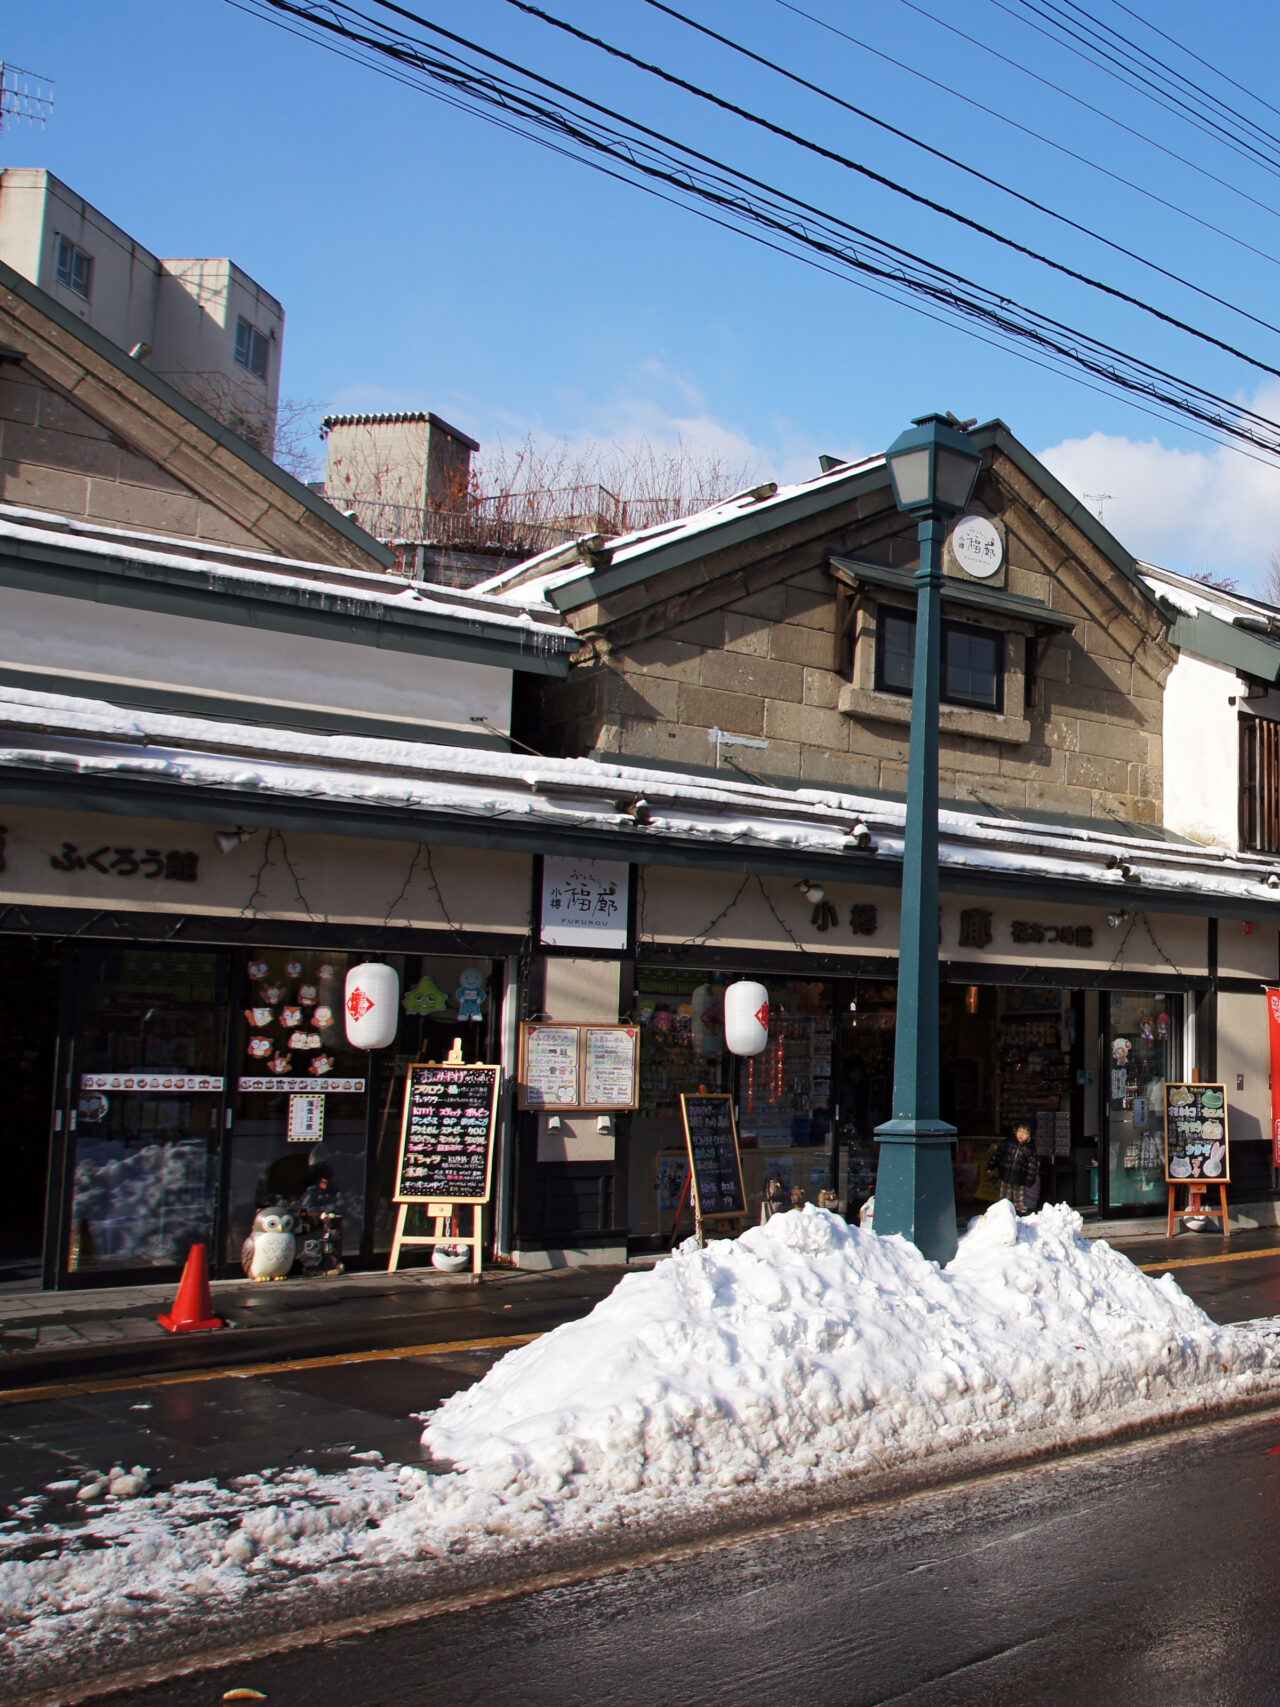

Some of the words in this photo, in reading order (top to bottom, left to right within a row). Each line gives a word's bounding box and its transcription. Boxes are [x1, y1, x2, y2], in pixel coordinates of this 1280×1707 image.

[51, 842, 200, 882] ふくろう館
[561, 918, 609, 927] FUKUROU
[811, 901, 878, 936] 小樽
[1011, 919, 1094, 948] 福あつめ館
[419, 1069, 467, 1083] おみやげ
[413, 1084, 444, 1095] フクロウ
